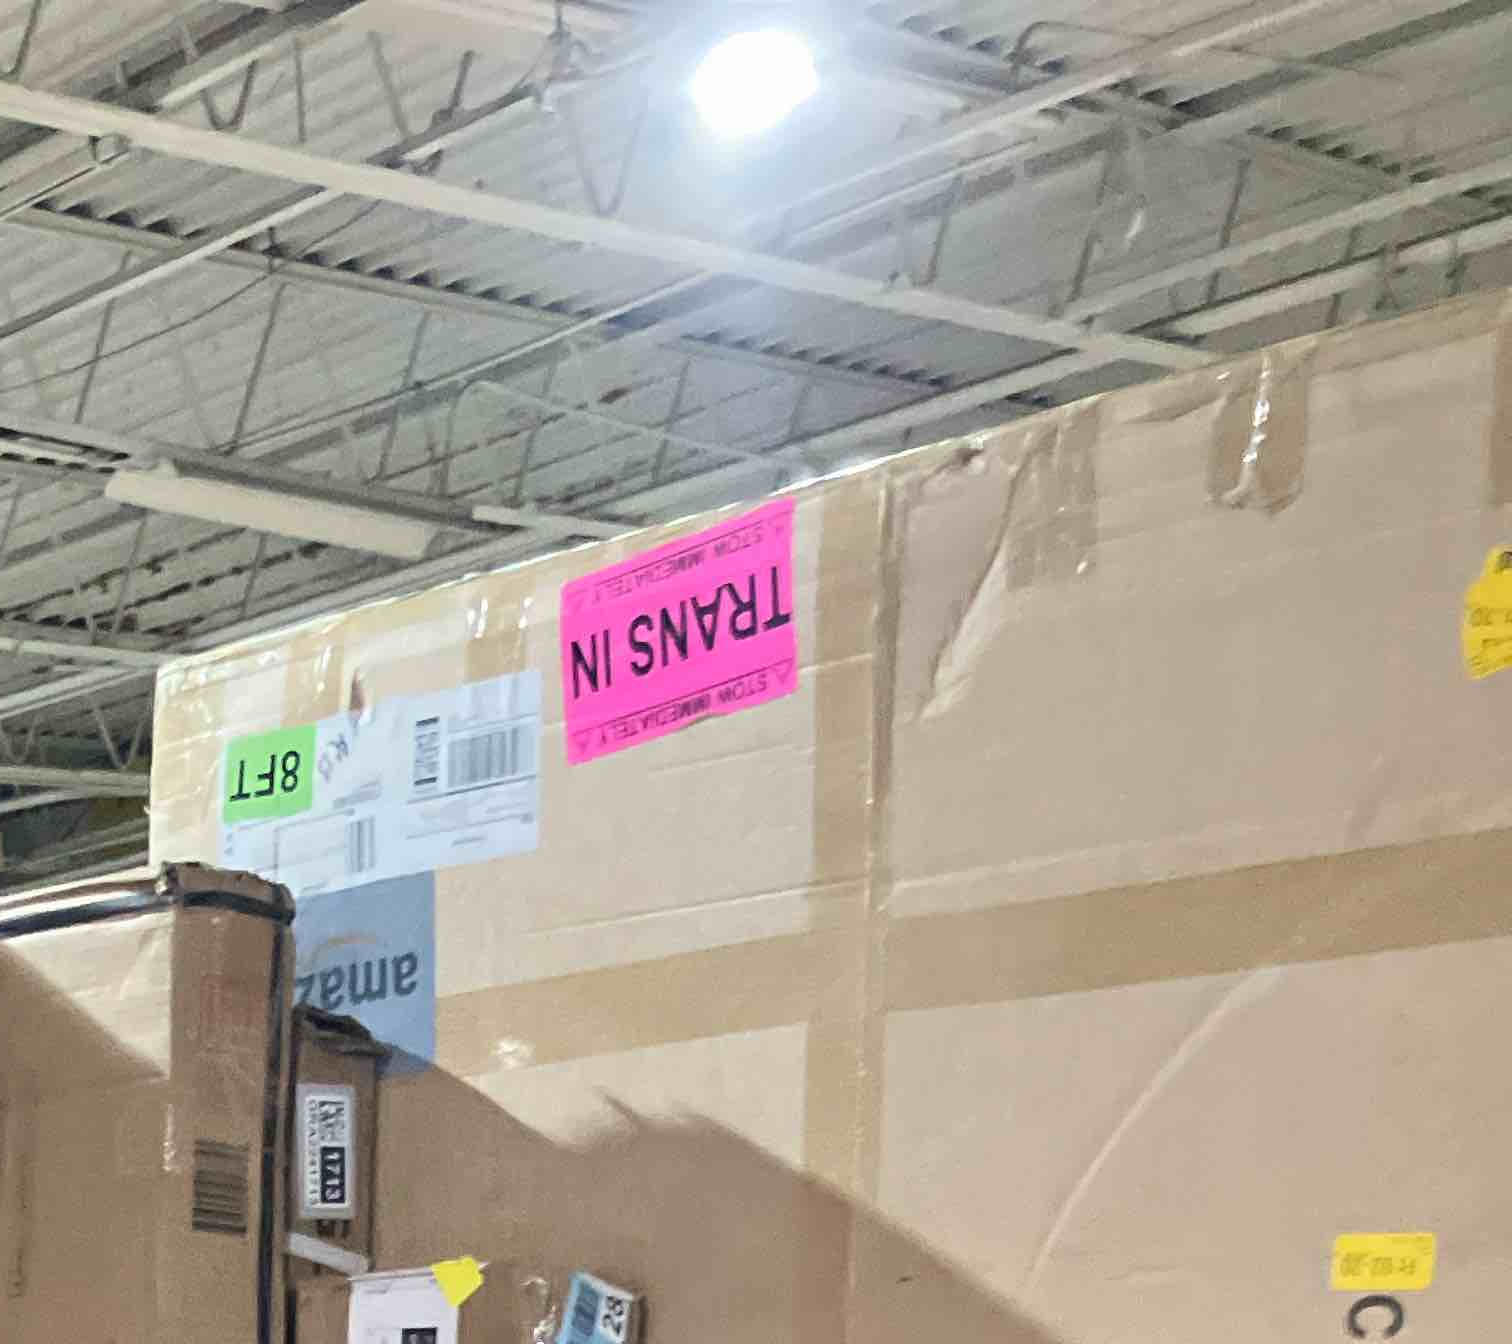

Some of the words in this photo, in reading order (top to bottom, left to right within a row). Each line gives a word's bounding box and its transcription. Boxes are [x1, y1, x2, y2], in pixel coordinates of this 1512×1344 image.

[627, 565, 792, 677] TRANS
[570, 629, 612, 700] IN
[229, 749, 301, 802] 8FT
